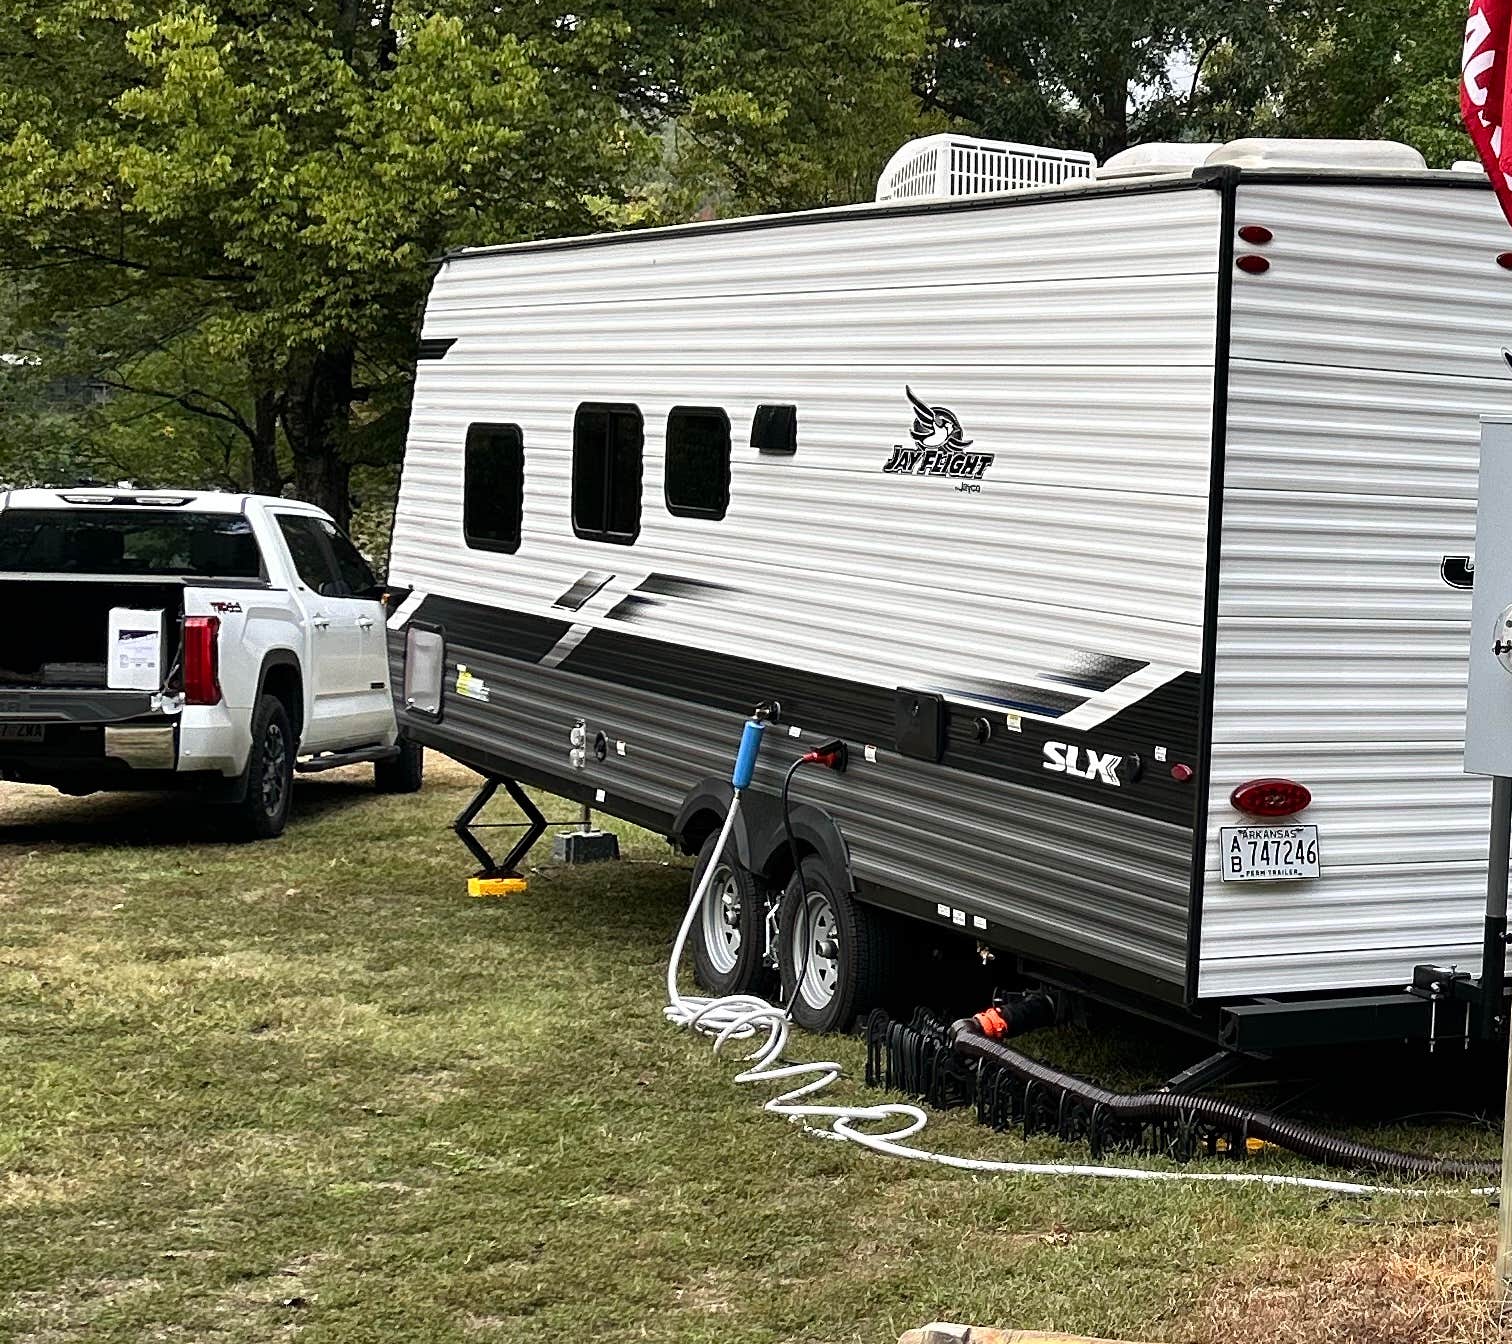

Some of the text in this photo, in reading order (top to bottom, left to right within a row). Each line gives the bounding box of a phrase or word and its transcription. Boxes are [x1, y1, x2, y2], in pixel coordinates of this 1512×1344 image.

[883, 445, 995, 479] JAY FLIGHT
[1242, 829, 1297, 840] ARKANSAS
[1248, 839, 1317, 866] 747246
[1268, 868, 1298, 876] TRAILER
